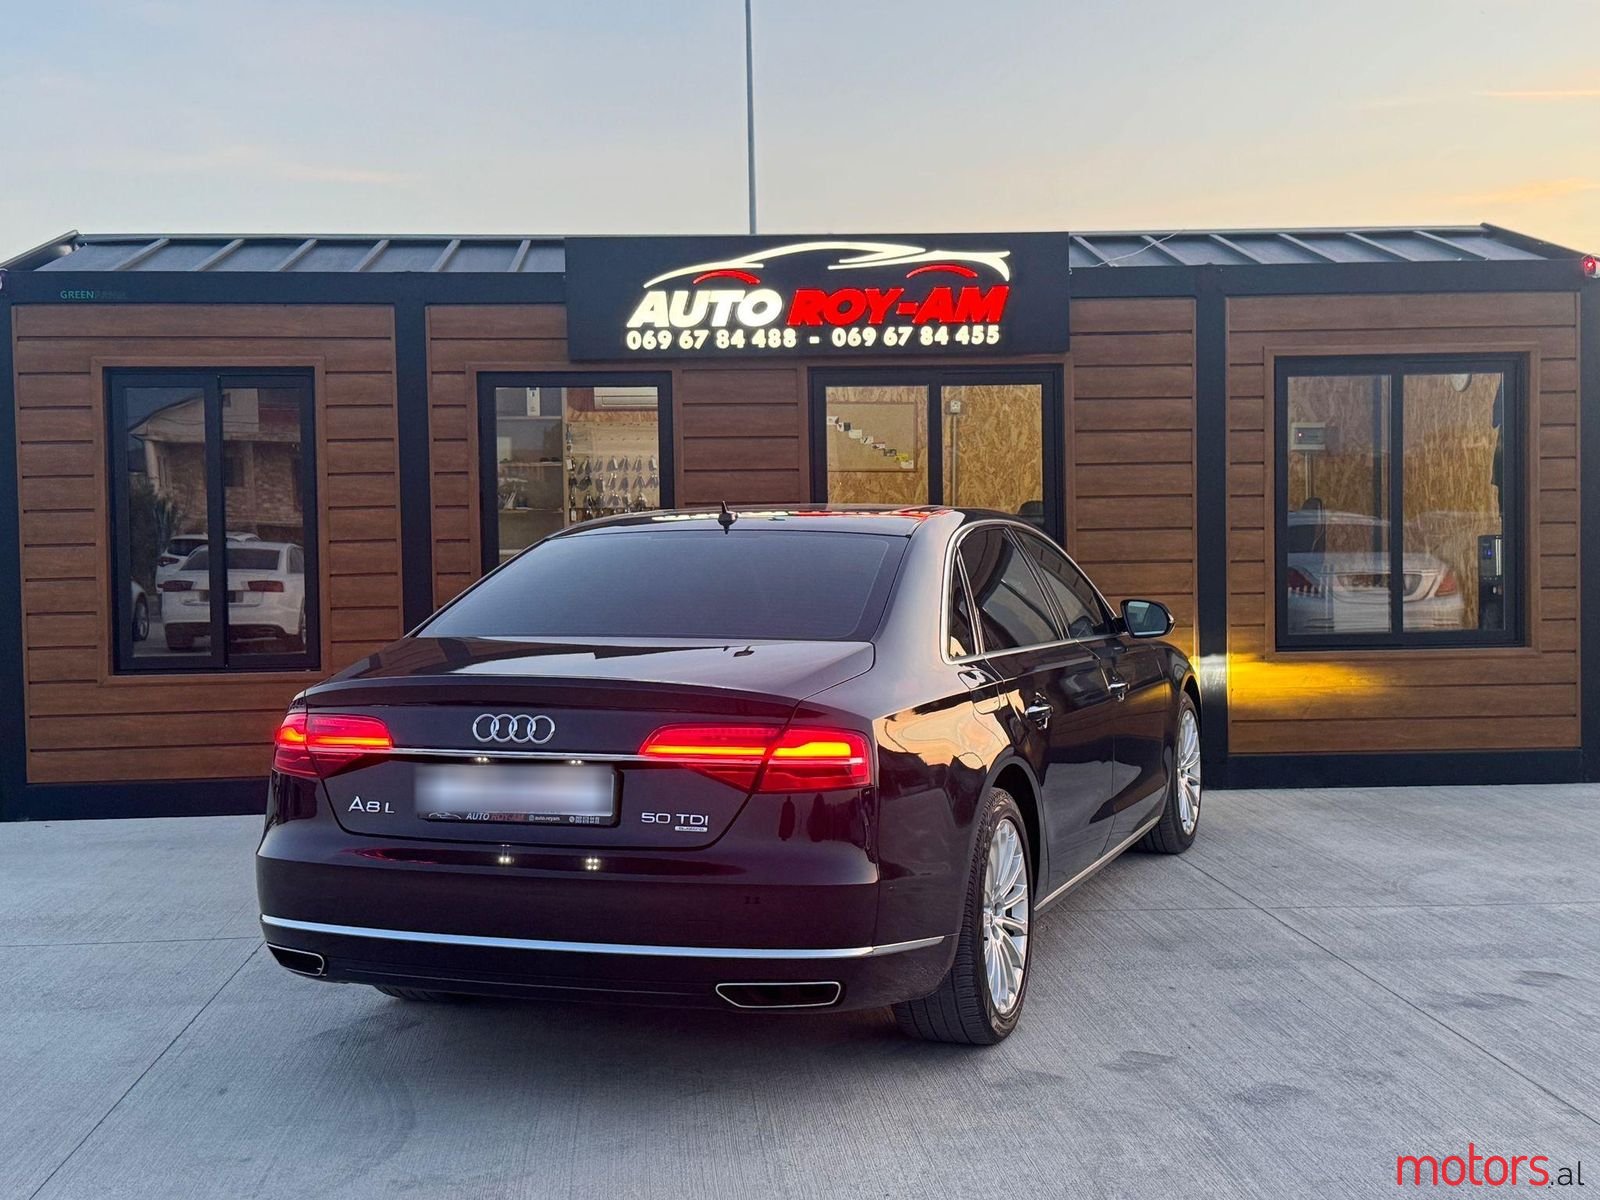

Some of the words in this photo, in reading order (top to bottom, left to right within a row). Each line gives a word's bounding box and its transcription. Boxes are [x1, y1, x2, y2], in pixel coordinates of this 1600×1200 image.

[60, 290, 95, 299] GREEN
[626, 288, 783, 328] AUTO
[786, 285, 1010, 326] ROY-AM
[626, 329, 671, 351] 069
[678, 329, 710, 350] 67
[715, 329, 746, 350] 84
[751, 328, 797, 349] 488
[808, 336, 820, 344] -
[831, 326, 877, 348] 069
[883, 326, 914, 347] 67
[920, 326, 949, 346] 84
[955, 325, 1000, 345] 455
[347, 795, 381, 813] A8
[465, 812, 490, 821] AUTO
[641, 812, 671, 824] 50
[675, 813, 709, 826] TDI
